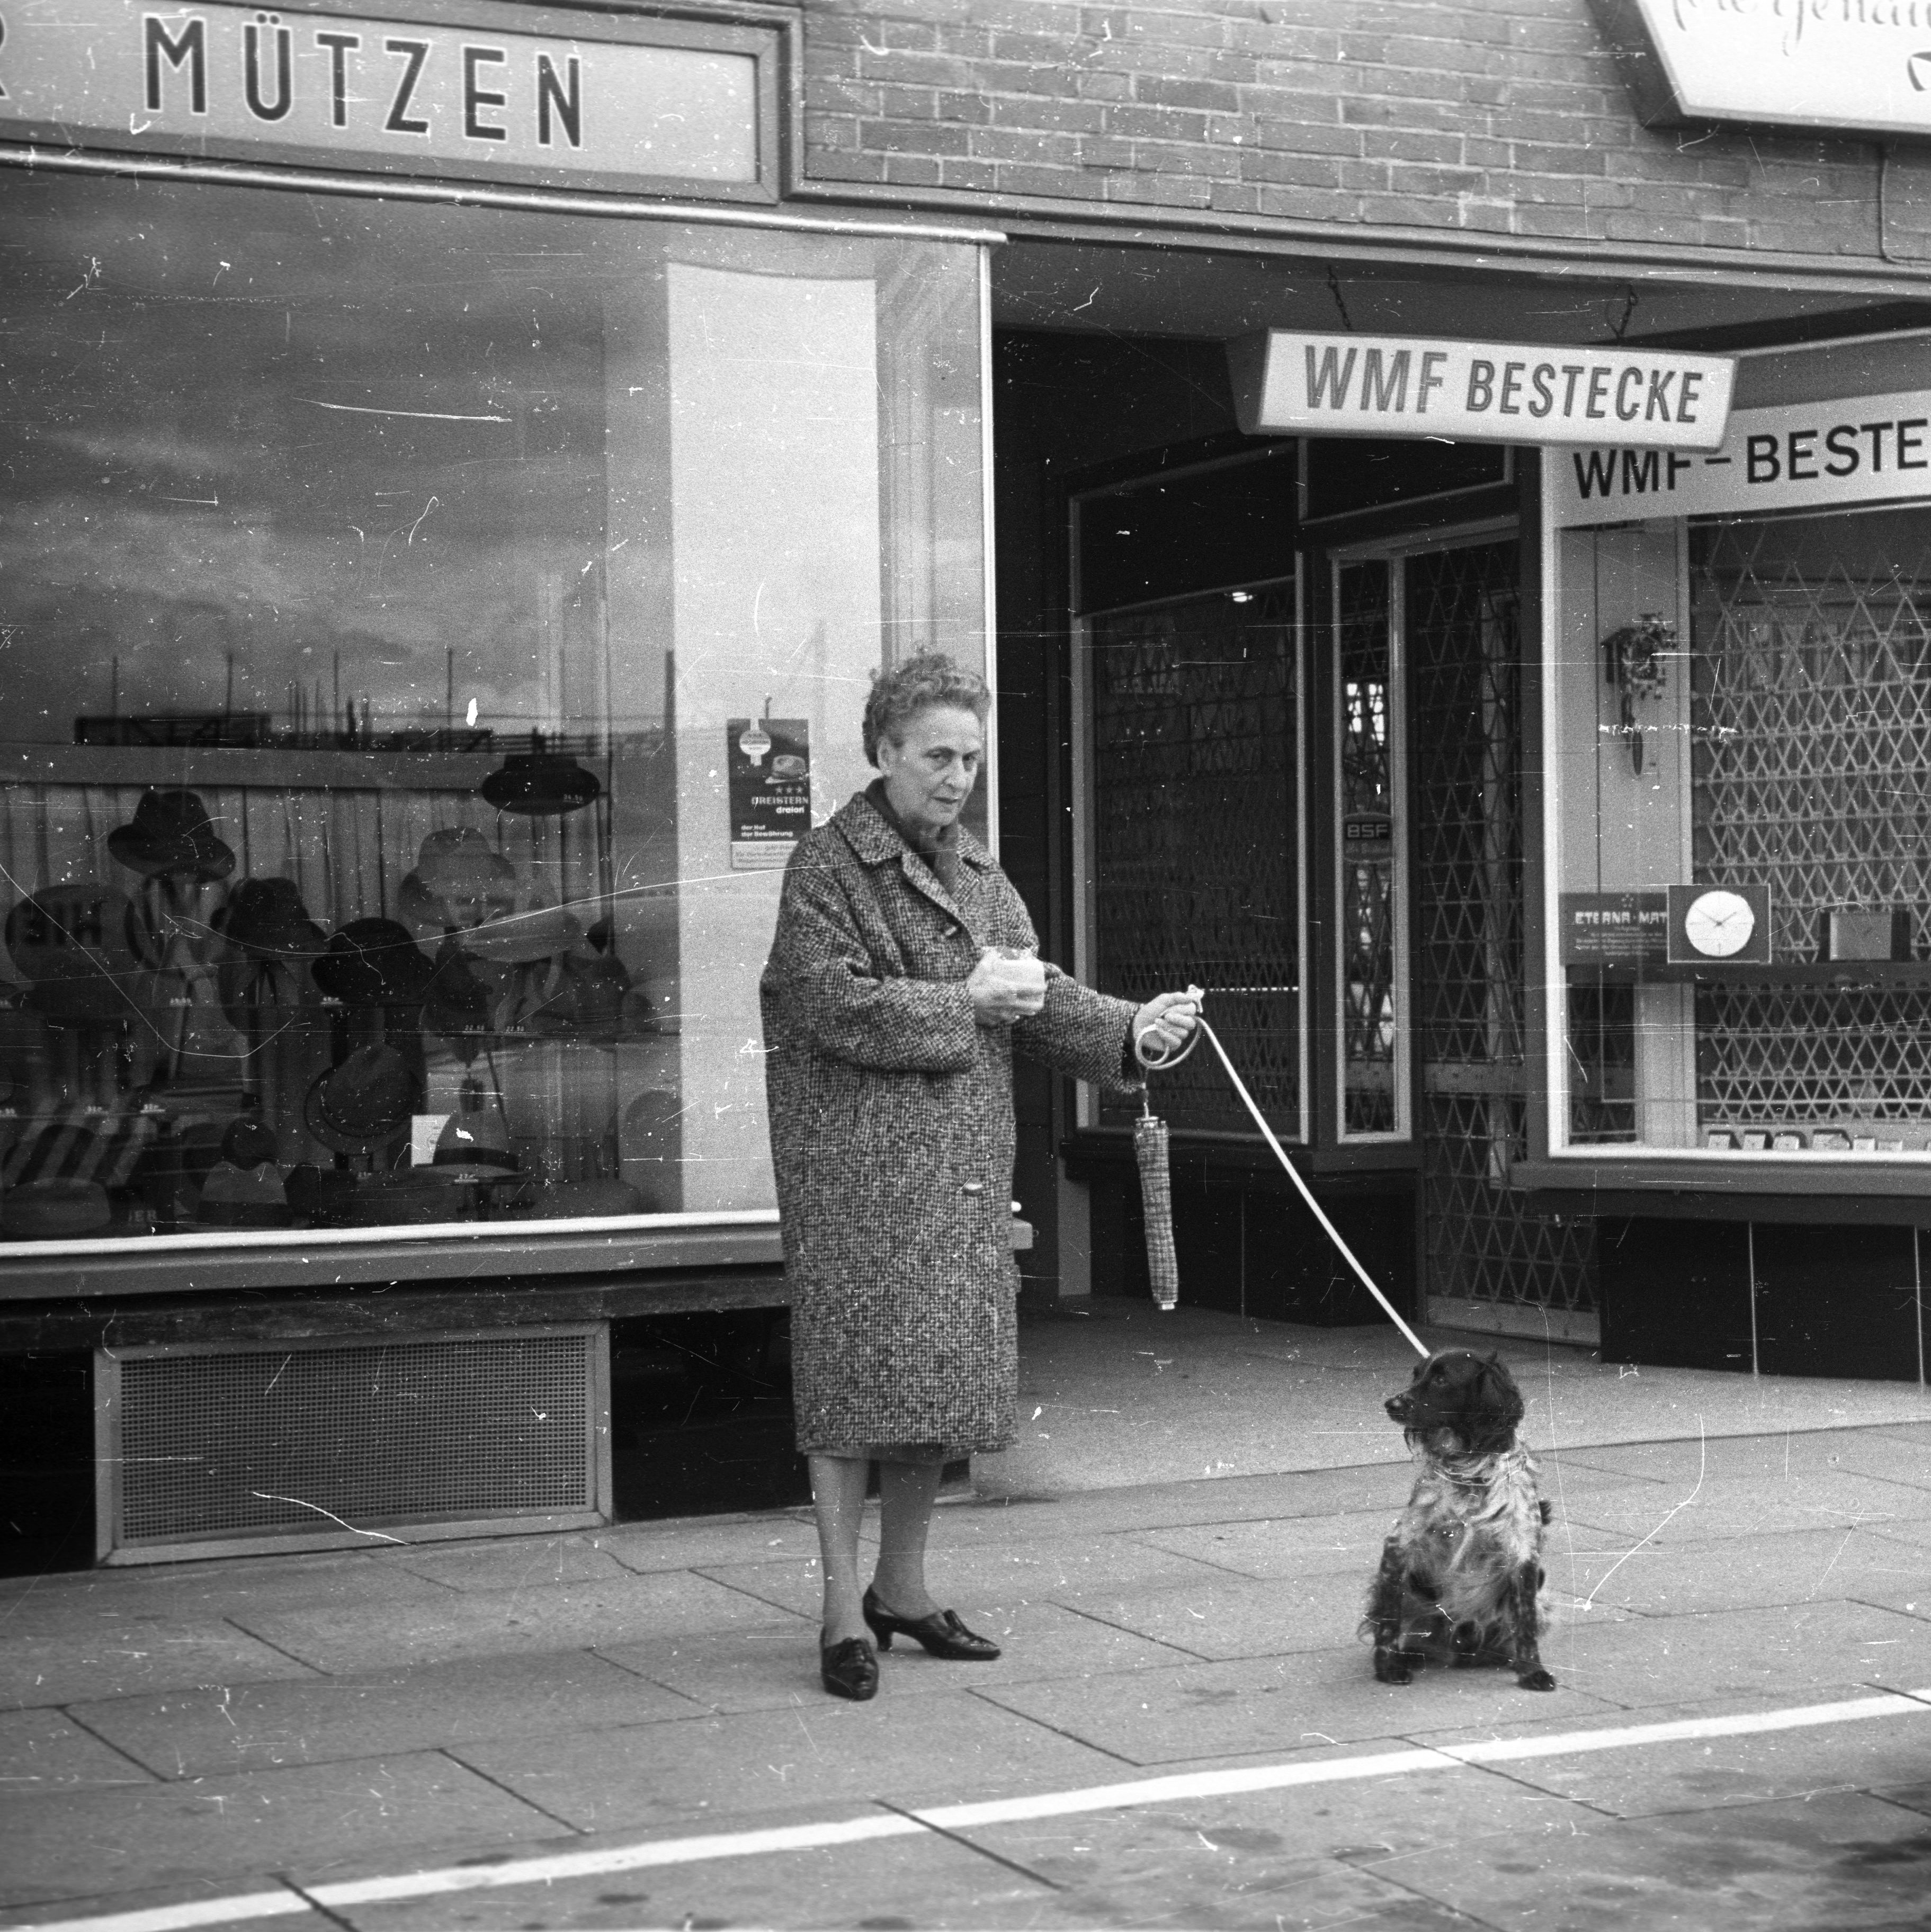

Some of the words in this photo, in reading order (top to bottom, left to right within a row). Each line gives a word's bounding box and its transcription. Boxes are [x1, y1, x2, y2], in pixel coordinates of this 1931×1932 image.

[146, 13, 580, 148] MÜTZEN
[1304, 344, 1448, 414] WMF
[1465, 359, 1703, 423] BESTECKE
[751, 796, 809, 804] DREISTERN
[775, 806, 804, 814] dralon
[1347, 824, 1388, 838] BSF
